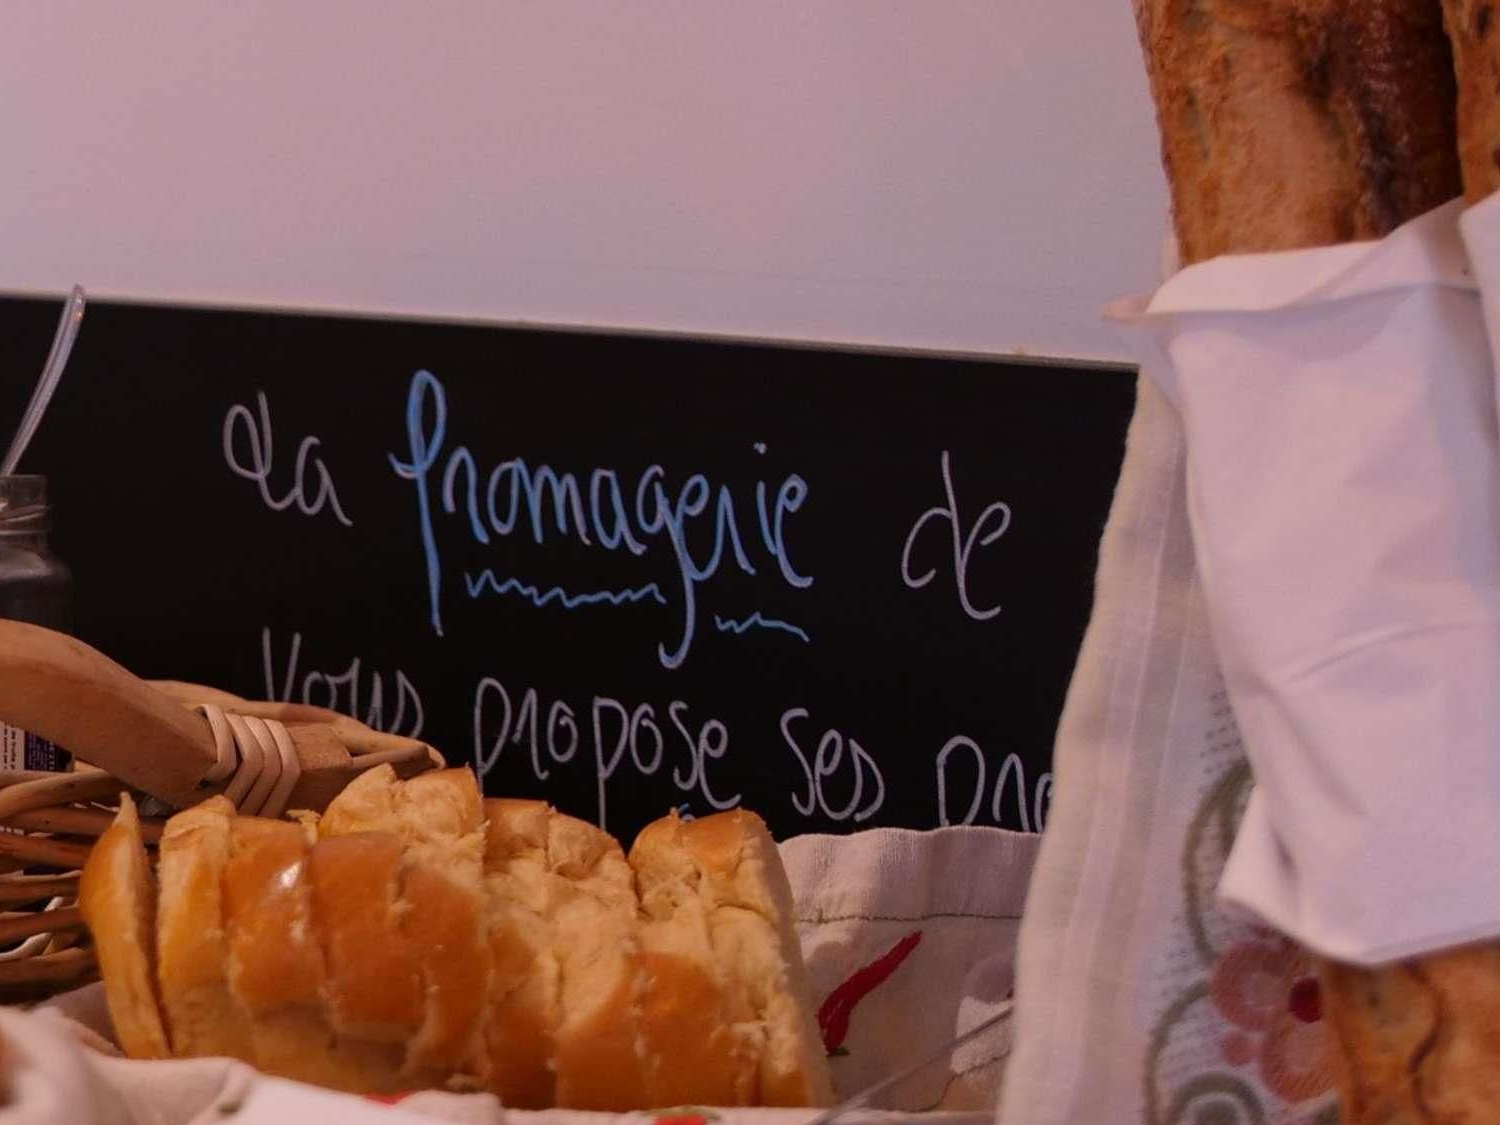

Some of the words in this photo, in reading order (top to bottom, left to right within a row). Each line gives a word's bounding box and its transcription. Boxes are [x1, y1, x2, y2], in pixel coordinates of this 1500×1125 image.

[388, 369, 814, 670] fromagerie
[901, 450, 1012, 621] de
[474, 676, 742, 831] propose
